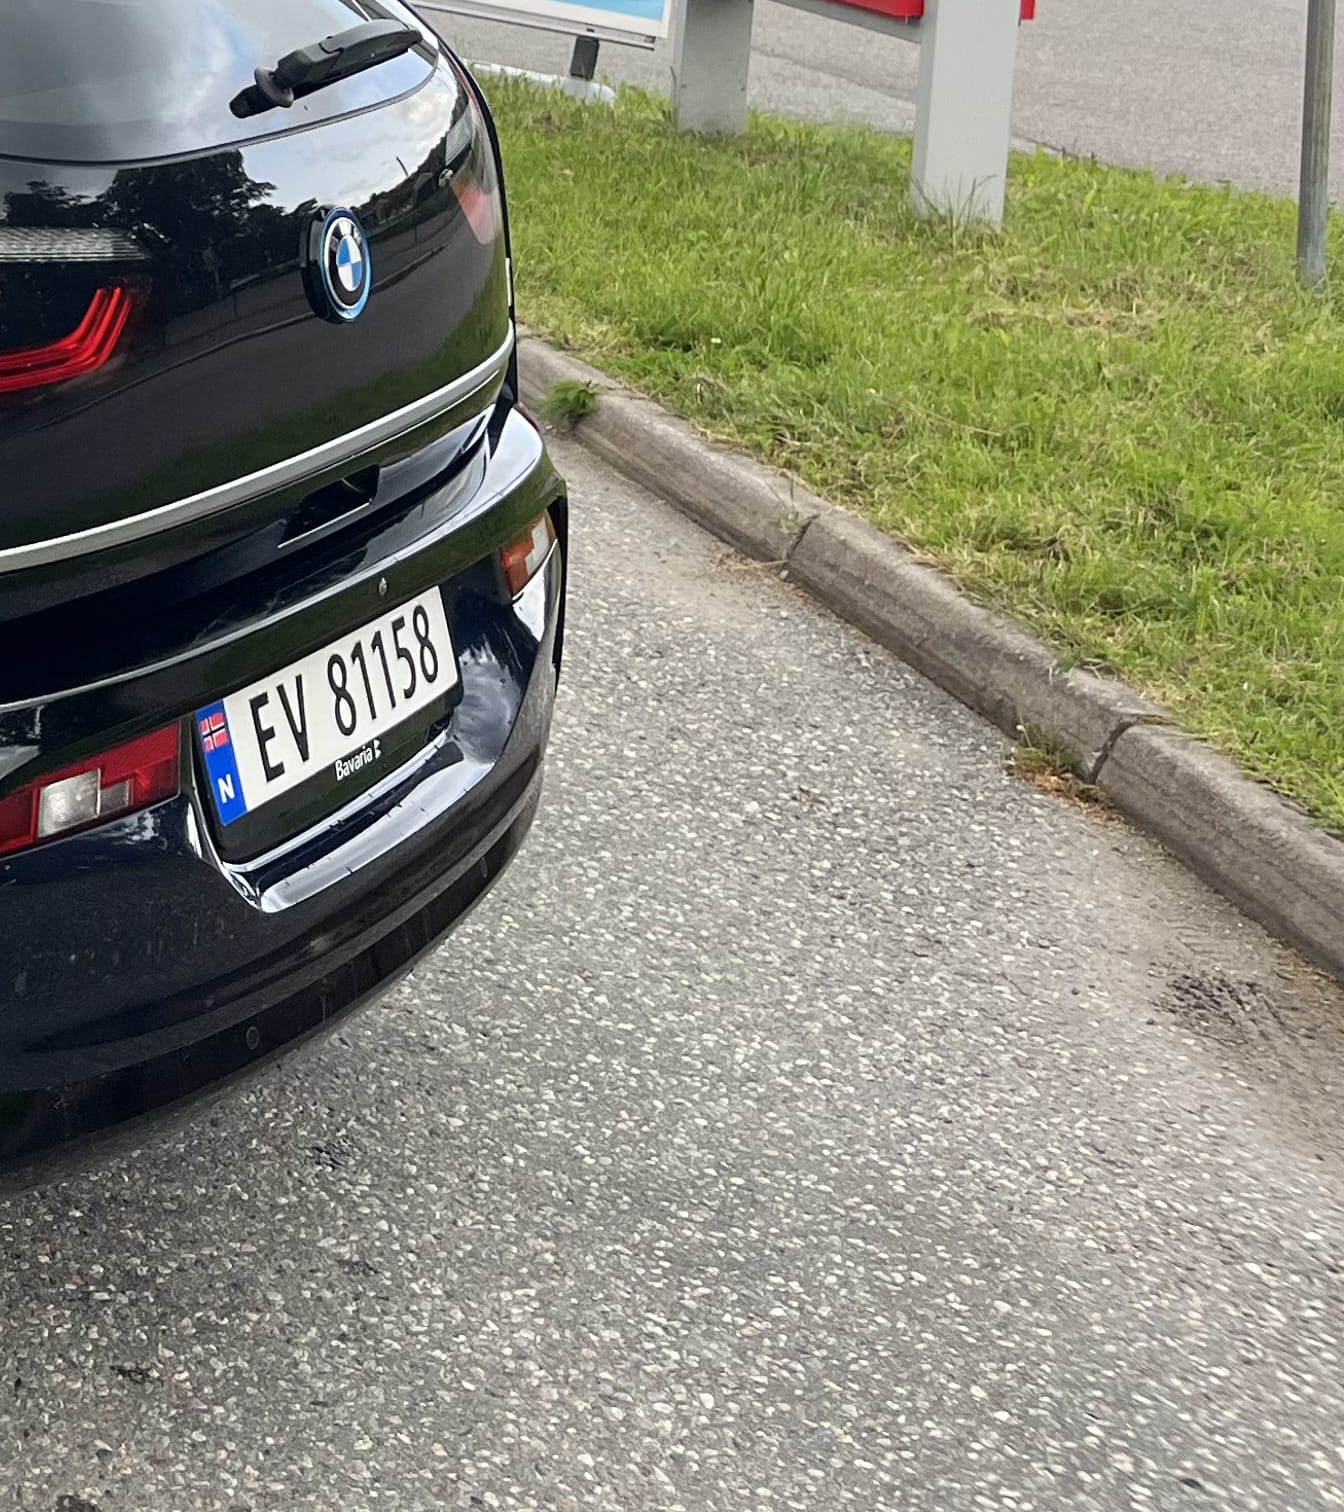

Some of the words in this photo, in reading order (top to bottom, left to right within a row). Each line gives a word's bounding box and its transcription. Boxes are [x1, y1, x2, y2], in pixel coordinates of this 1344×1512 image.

[248, 673, 310, 784] EV
[327, 604, 439, 736] 81158
[335, 745, 373, 781] Bavaria
[217, 774, 236, 804] N
